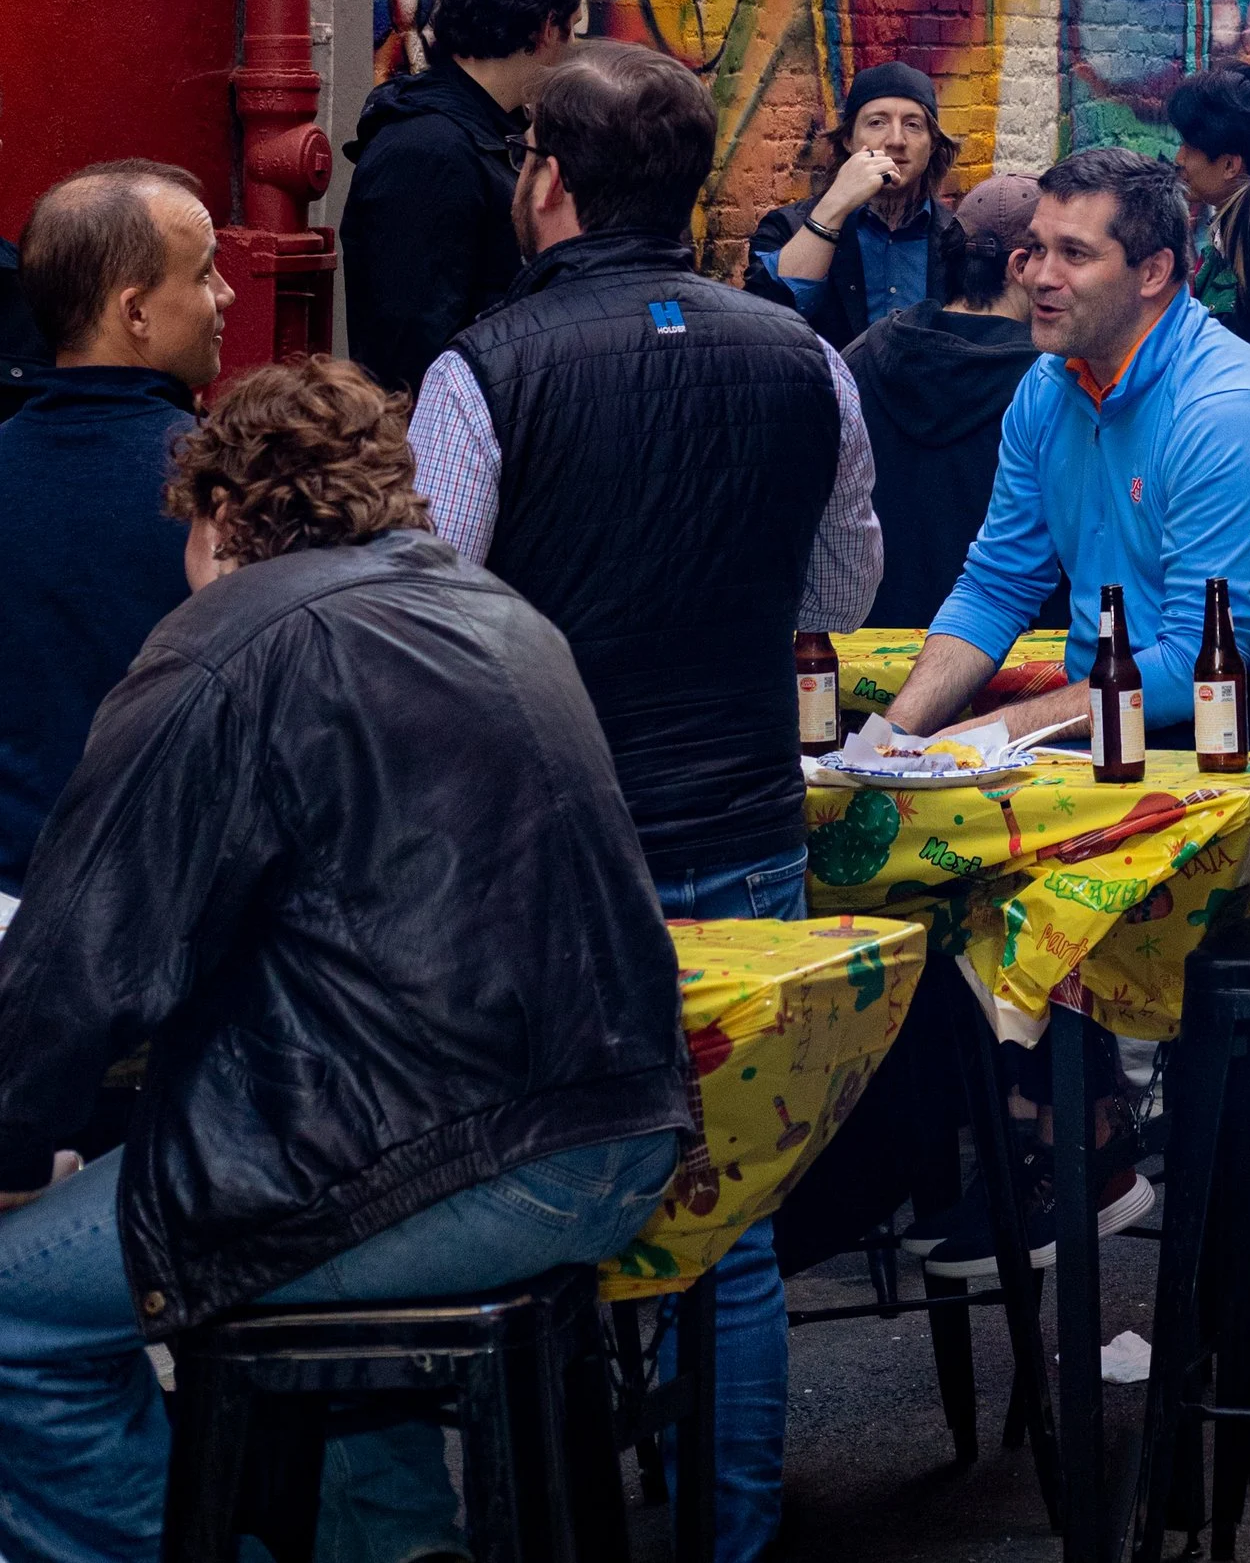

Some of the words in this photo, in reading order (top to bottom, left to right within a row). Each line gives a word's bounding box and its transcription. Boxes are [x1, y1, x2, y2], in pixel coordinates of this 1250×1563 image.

[656, 324, 687, 335] HOLDER
[853, 676, 897, 706] Mex
[919, 836, 983, 876] Mexi
[1036, 923, 1089, 968] part
